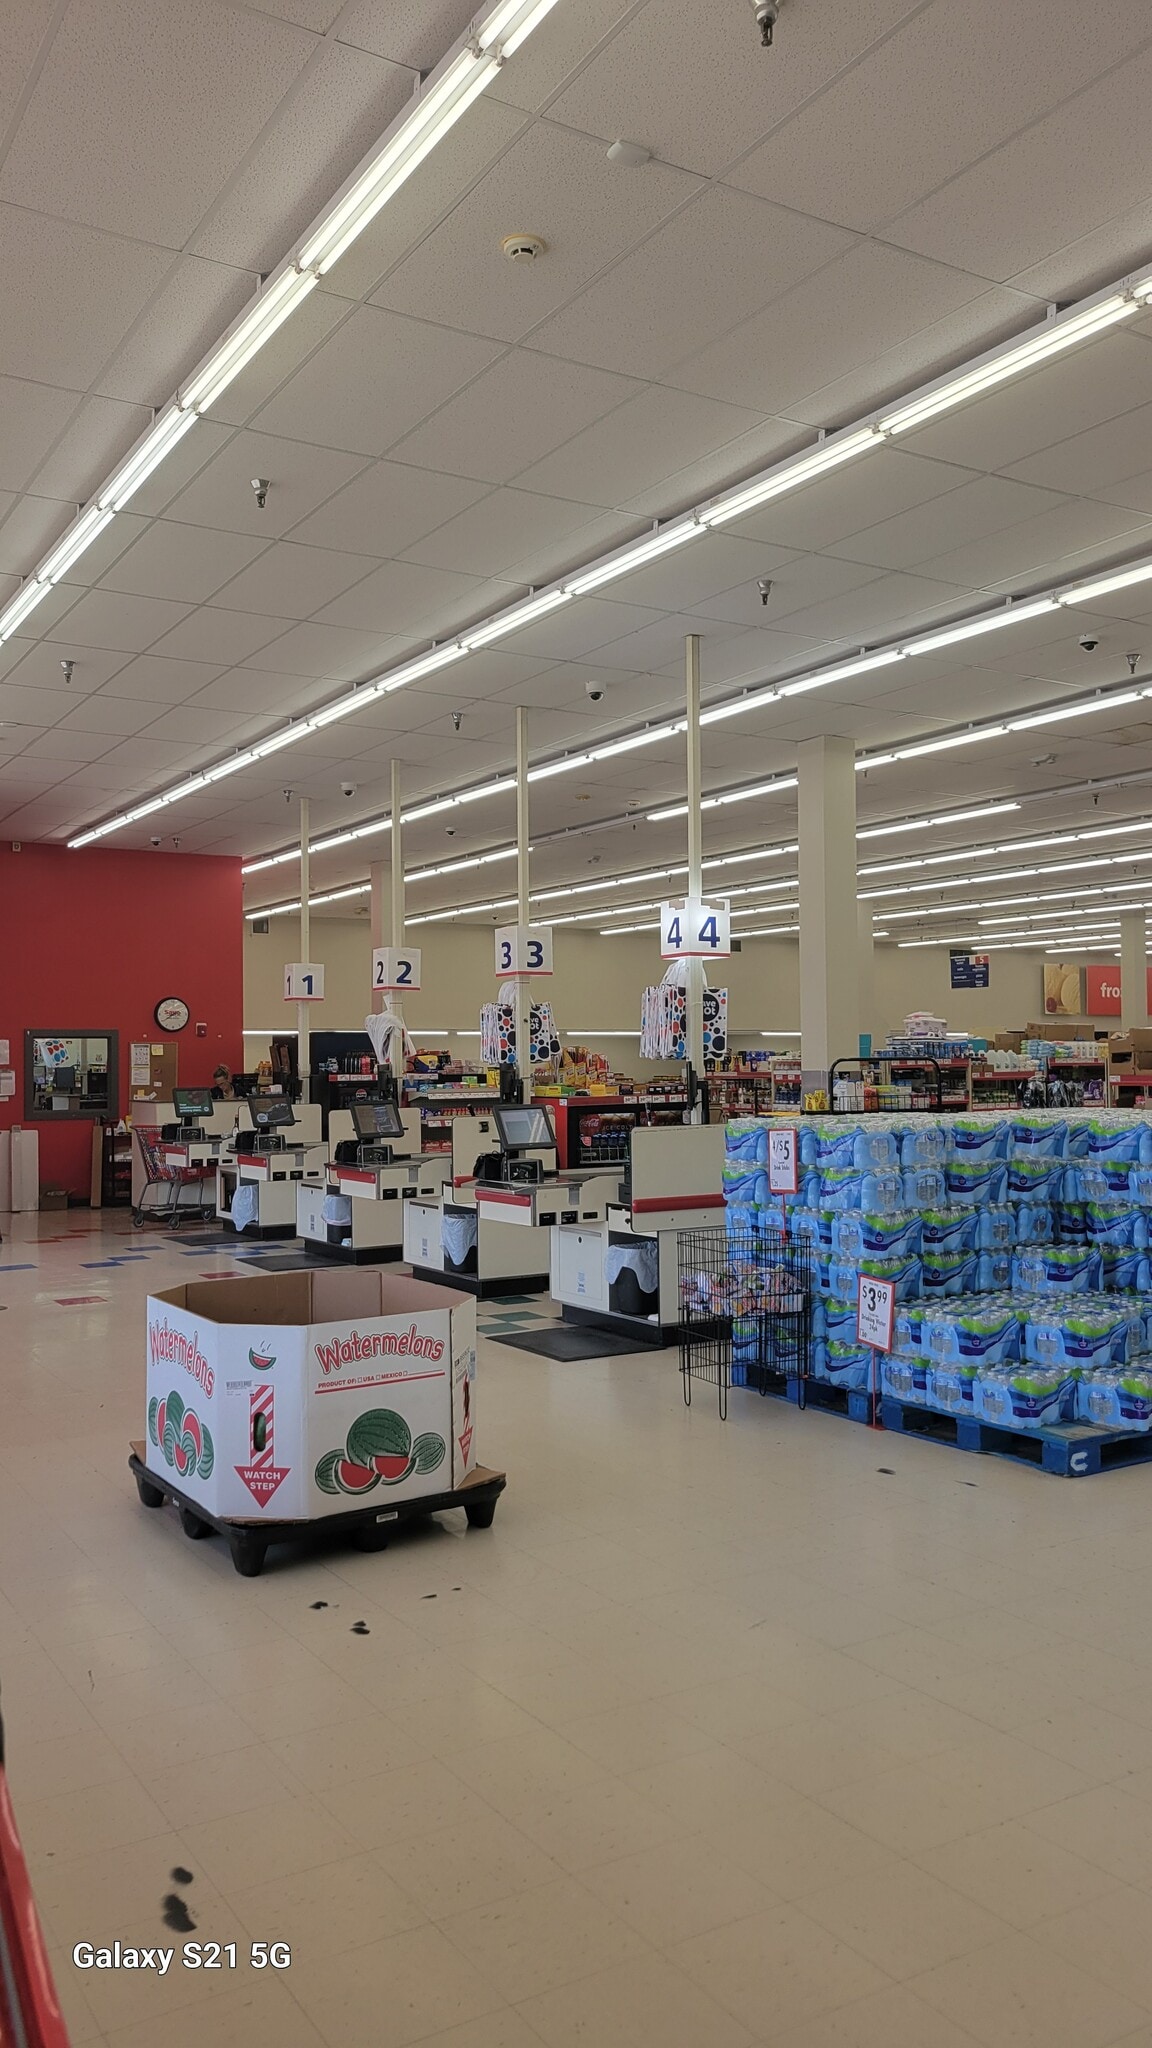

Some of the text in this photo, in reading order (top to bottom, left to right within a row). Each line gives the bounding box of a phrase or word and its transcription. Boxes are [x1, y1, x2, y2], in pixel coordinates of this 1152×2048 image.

[667, 916, 683, 949] 4
[698, 916, 721, 948] 4
[501, 941, 512, 969] 3
[527, 940, 544, 968] 3
[376, 960, 384, 984] 2
[396, 960, 412, 984] 2
[286, 975, 291, 996] 1
[301, 974, 313, 995] 1
[1100, 982, 1121, 998] fro
[148, 1316, 216, 1400] Watermelons
[314, 1323, 445, 1375] Watermelons
[318, 1379, 346, 1388] PRODUCT
[381, 1372, 403, 1380] MEXICO
[244, 1470, 281, 1480] WATCH
[250, 1482, 275, 1490] STEP
